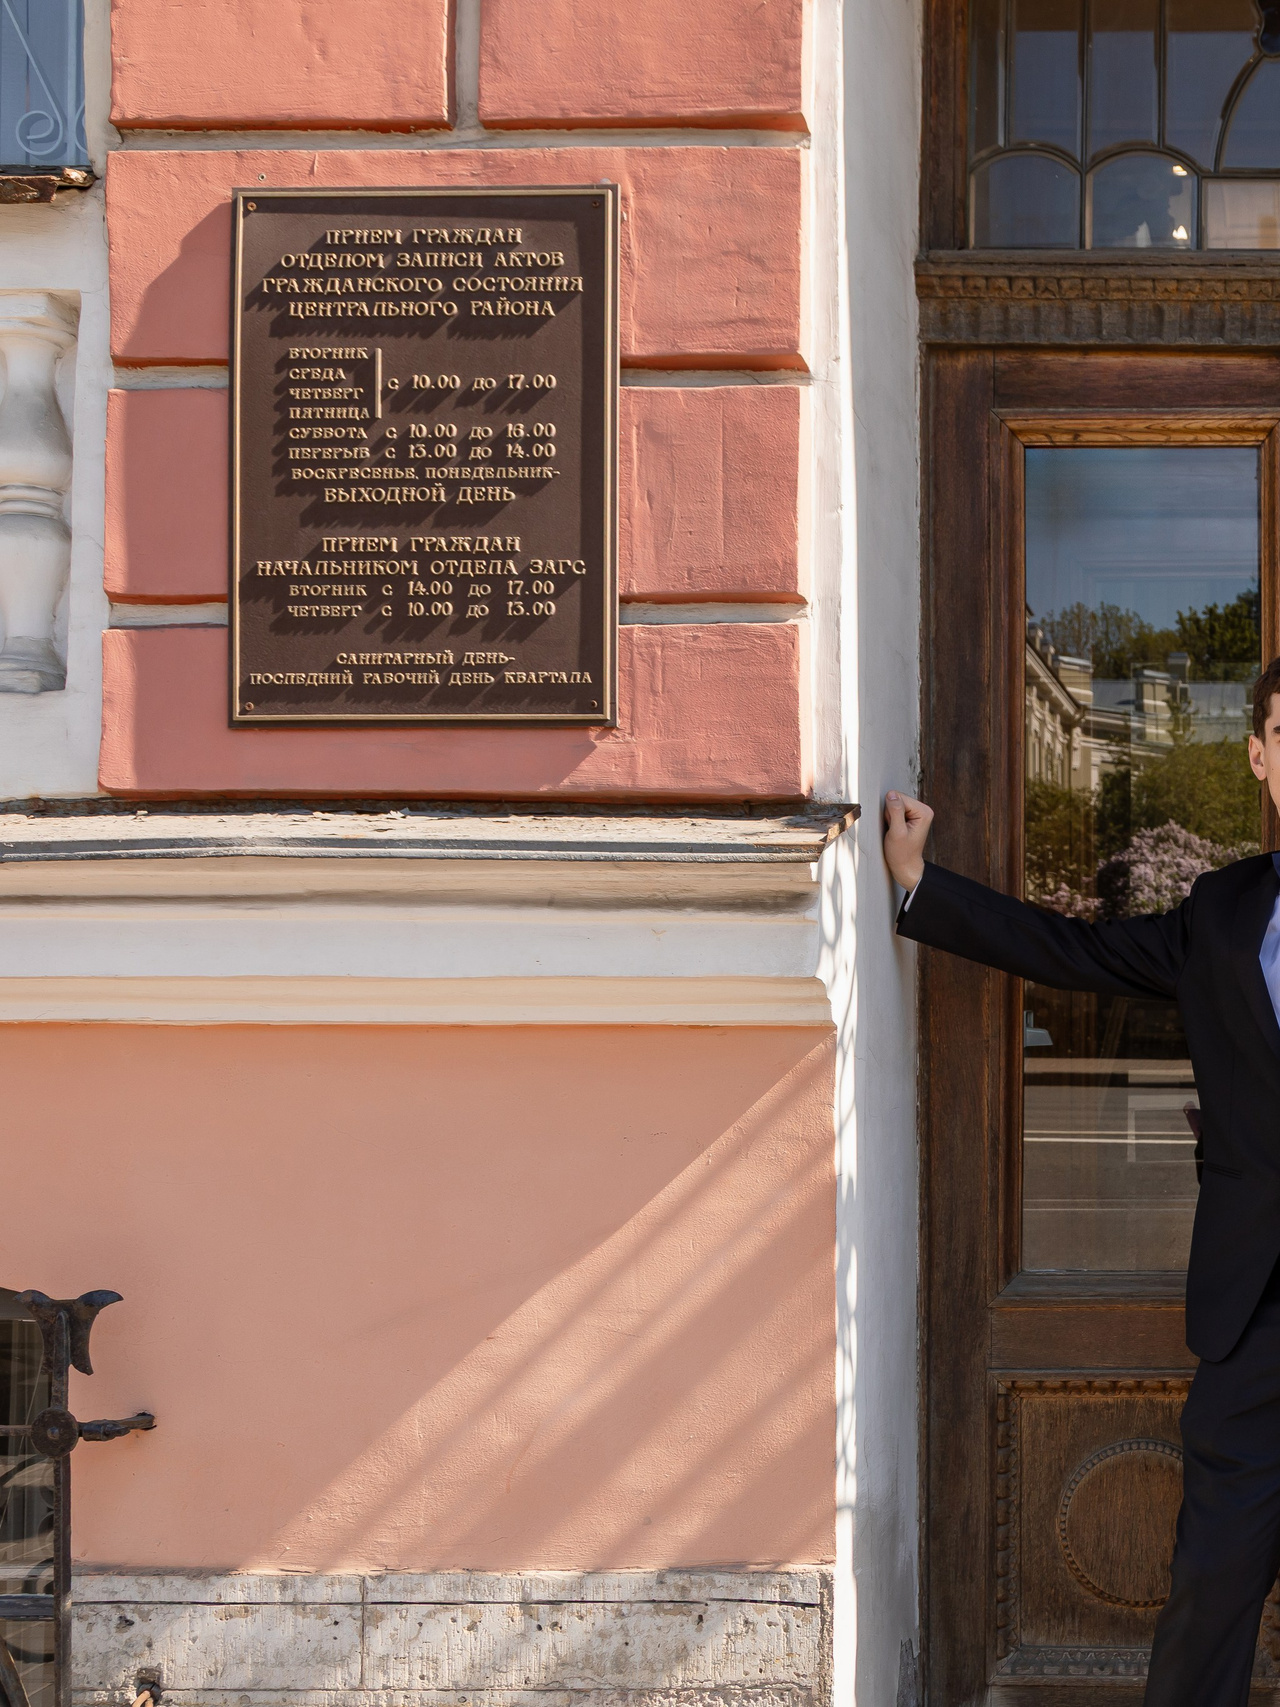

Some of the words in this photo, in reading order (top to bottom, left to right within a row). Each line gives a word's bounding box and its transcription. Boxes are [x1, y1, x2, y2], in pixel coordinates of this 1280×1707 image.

[325, 228, 402, 244] ПРИЕМ
[412, 228, 522, 246] ГРАЖДАН
[281, 253, 385, 270] ОТДЕЛОМ
[397, 252, 483, 268] ЗАПИСИ
[494, 252, 564, 267] АКТОВ
[262, 277, 443, 294] ГРАЖДАНСКОГО
[452, 277, 584, 292] СОСТОЯНИЯ
[289, 301, 458, 319] ЦЕНТРАЛЬНОГО
[470, 298, 556, 317] РАЙОНА
[288, 348, 368, 360] ВТОРНИК
[288, 368, 346, 381] СРЕДА
[412, 375, 461, 389] 10.00
[507, 374, 557, 389] 17.00
[288, 388, 364, 400] ЧЕТВЕРГ
[288, 407, 371, 421] ПЯТНИЦА
[288, 427, 368, 440] СУББОТА
[408, 424, 458, 438] 10.00
[506, 423, 556, 438] 16.00
[288, 447, 371, 459] ПЕРЕРЫВ
[408, 444, 457, 458] 13.00
[506, 443, 556, 458] 14.00
[324, 482, 447, 505] ВЫХОДНОЙ
[457, 487, 516, 504] ДЕНЬ
[322, 537, 398, 553] ПРИЕМ
[410, 536, 521, 554] ГРАЖДАН
[257, 561, 418, 576] НАЧАЛЬНИКОМ
[430, 560, 518, 578] ОТДЕЛА
[530, 560, 587, 575] ЗАГС
[288, 584, 367, 596] ВТОРНИК
[407, 581, 453, 596] 14.00
[507, 581, 555, 595] 17.00
[288, 604, 363, 618] ЧЕТВЕРГ
[407, 602, 453, 617] 10.00
[506, 601, 556, 616] 13.00
[337, 650, 454, 665] САНИТАРНЫЙ
[249, 670, 354, 687] ПОСЛЕДНИЙ
[362, 670, 441, 685] РАБОЧИЙ
[448, 672, 495, 686] ДЕНЬ
[504, 672, 593, 684] КВАРТАЛА
